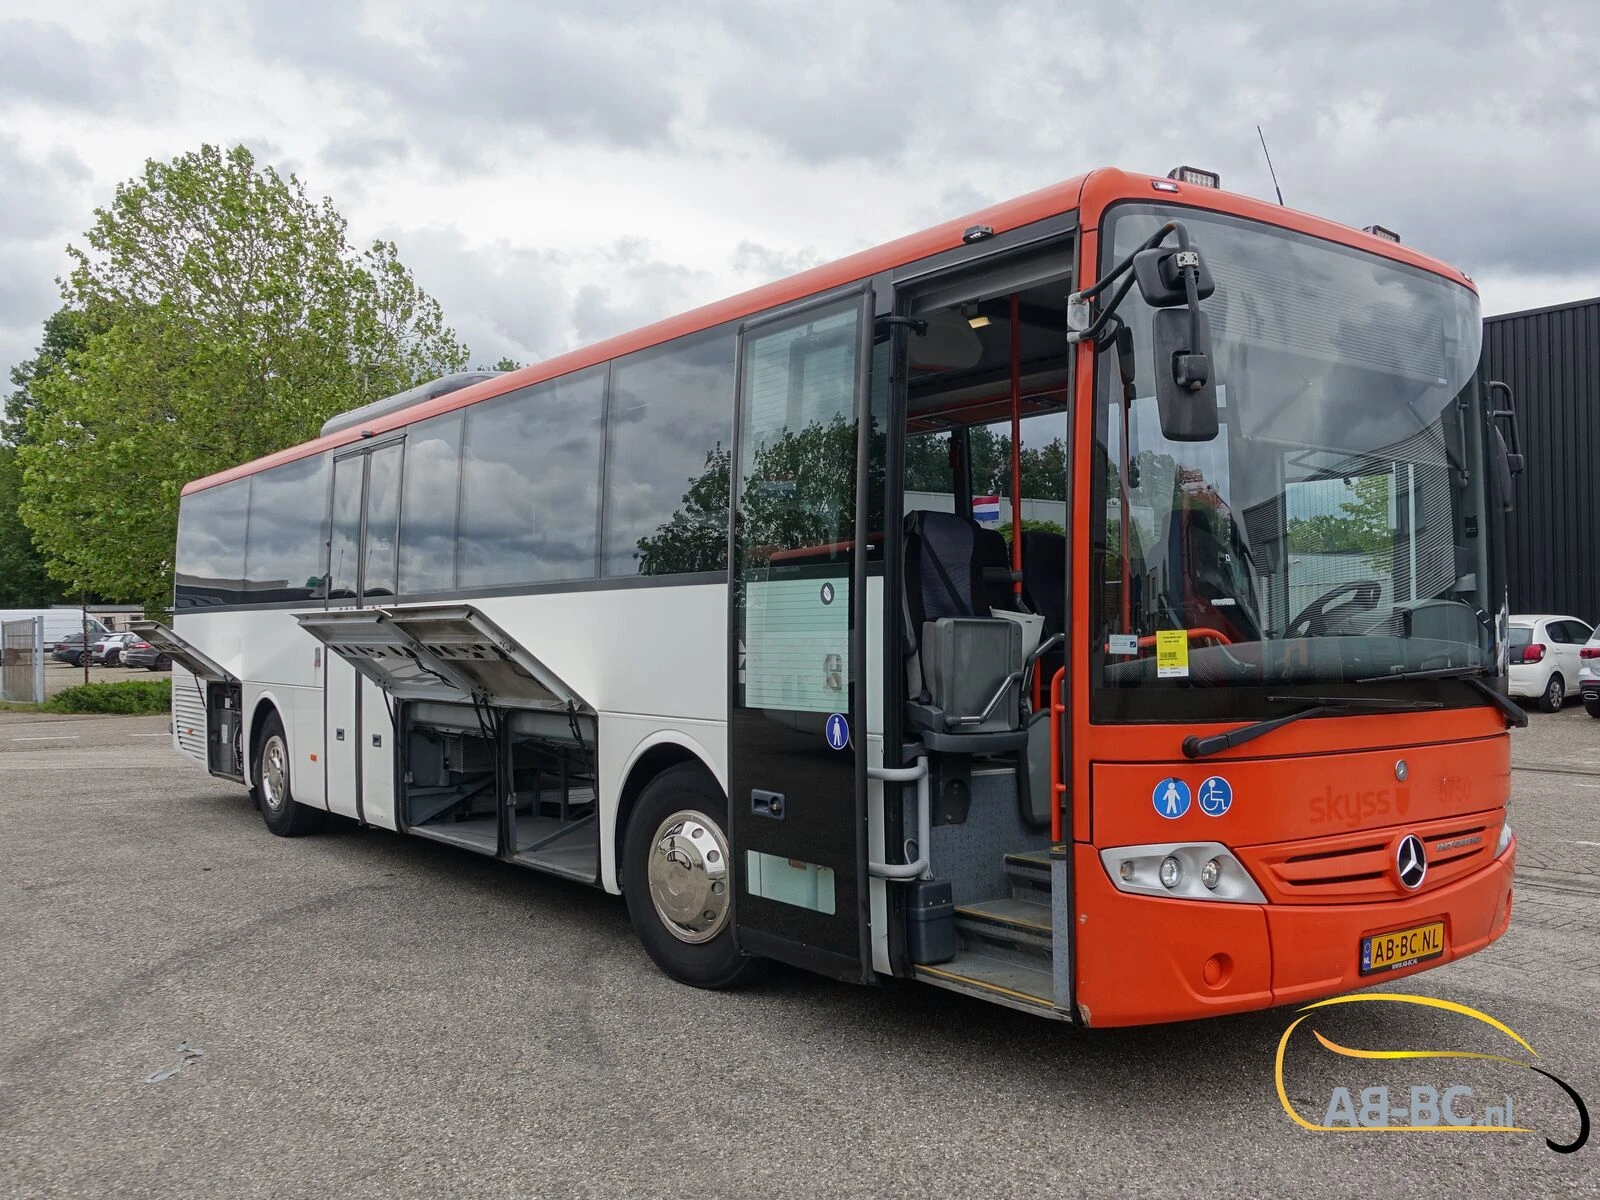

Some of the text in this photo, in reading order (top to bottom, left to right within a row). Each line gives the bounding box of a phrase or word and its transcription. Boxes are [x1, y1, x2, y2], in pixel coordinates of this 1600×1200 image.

[1309, 785, 1391, 828] skyss
[1363, 956, 1371, 965] NL
[1373, 928, 1439, 964] AB-BC.NL
